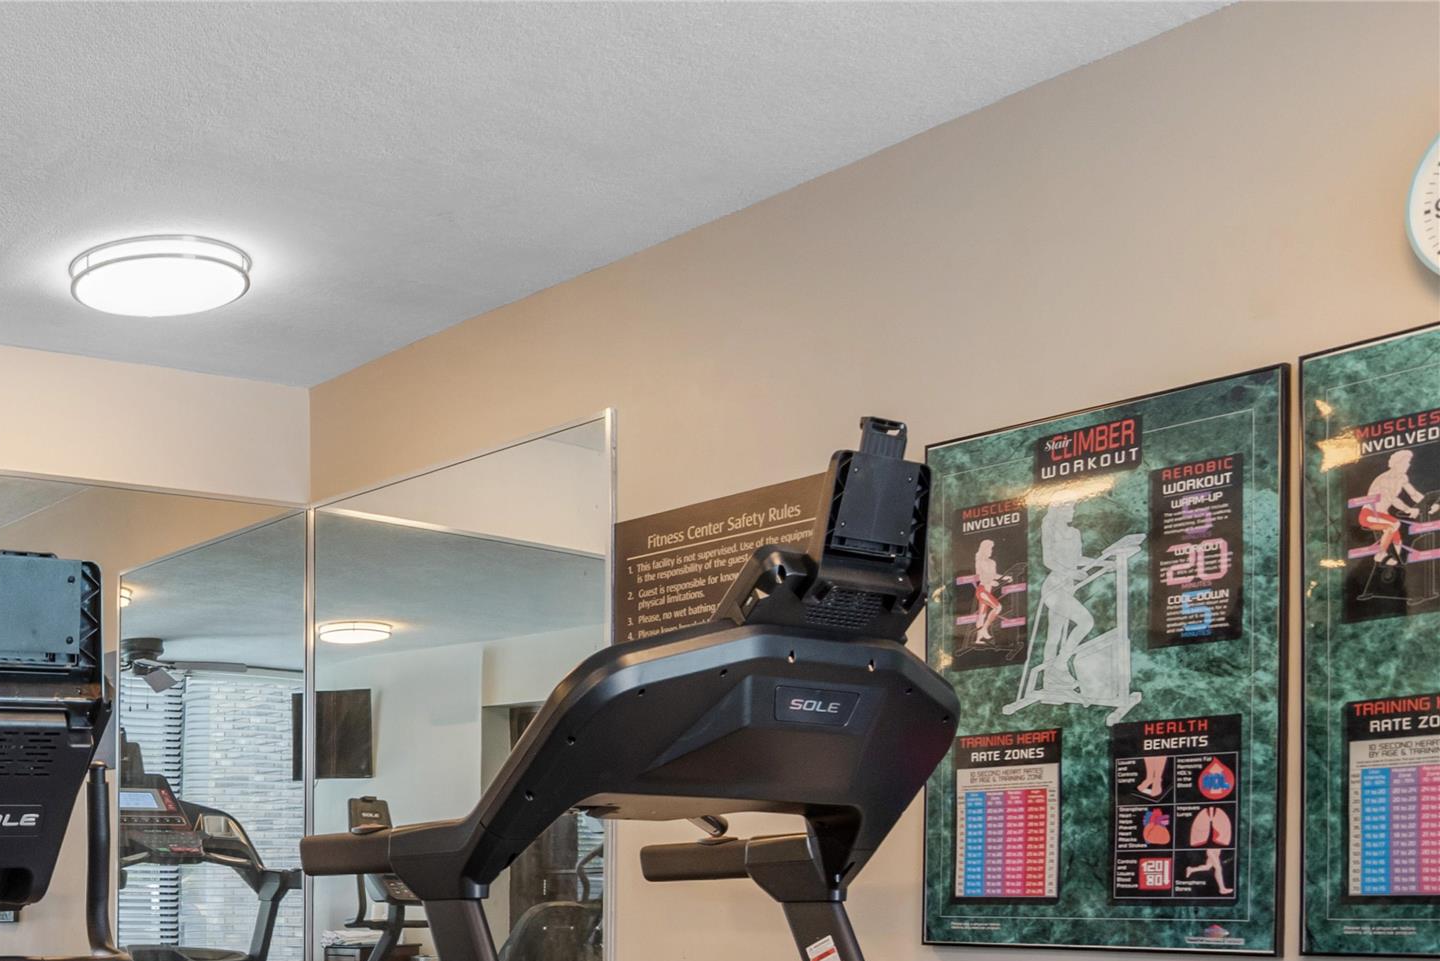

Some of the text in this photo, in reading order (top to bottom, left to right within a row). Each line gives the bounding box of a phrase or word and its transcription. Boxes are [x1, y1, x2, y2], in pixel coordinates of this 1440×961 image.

[1051, 419, 1135, 461] CLIMBER
[1041, 447, 1139, 479] WORKOUT
[1162, 457, 1233, 480] AEROBIC
[1162, 472, 1233, 495] WORKOUT
[962, 500, 1020, 519] MUSCLES
[1171, 491, 1223, 509] WARM-UP
[647, 504, 801, 549] Fitness Center Safety Rules
[962, 512, 1020, 532] INVOLVED
[636, 561, 651, 574] This
[652, 556, 674, 571] facility
[676, 555, 682, 564] is
[683, 552, 696, 562] not
[697, 544, 738, 562] supervised.
[740, 540, 754, 551] Use
[756, 537, 765, 548] of
[766, 534, 780, 545] the
[637, 574, 643, 583] is
[645, 572, 656, 582] the
[657, 563, 703, 582] responsibility
[704, 560, 713, 570] of
[715, 557, 727, 568] the
[638, 587, 657, 599] Guest
[659, 585, 665, 594] is
[666, 576, 706, 595] responsible
[707, 574, 719, 584] for
[638, 590, 705, 611] physical limitations.
[662, 611, 672, 620] no
[673, 608, 687, 618] wet
[688, 603, 716, 617] bathing
[789, 699, 840, 713] SOLE
[1353, 697, 1431, 716] TRAINING
[1144, 719, 1208, 735] HEALTH
[1370, 717, 1412, 733] RATE
[961, 730, 1057, 749] TRAINING HEART
[1143, 735, 1208, 751] BENEFITS
[971, 747, 1044, 762] RATE ZONES
